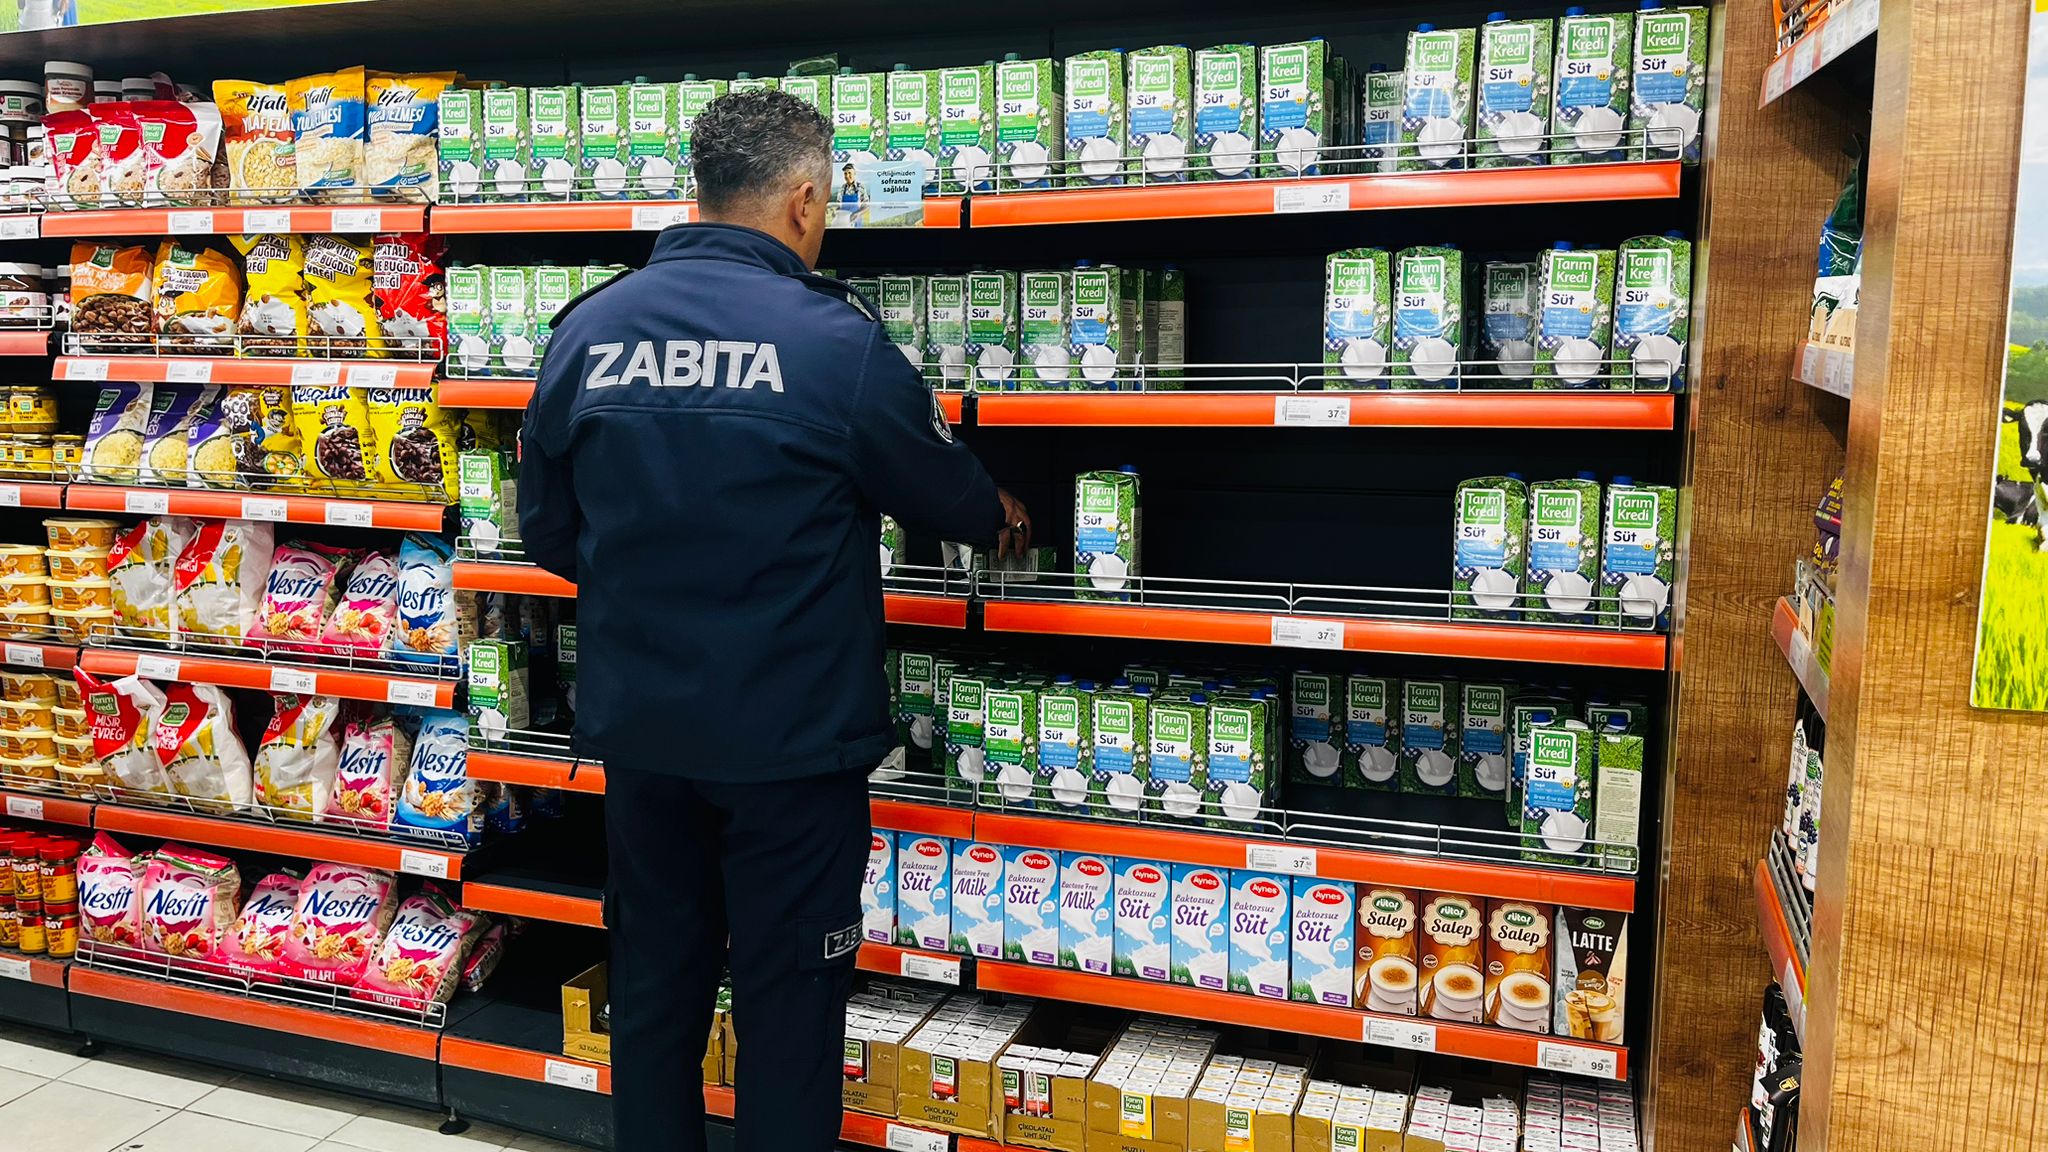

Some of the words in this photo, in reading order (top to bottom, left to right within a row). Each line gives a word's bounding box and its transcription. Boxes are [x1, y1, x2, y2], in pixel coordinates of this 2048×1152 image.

[1571, 22, 1608, 38] Tarım
[1646, 21, 1683, 33] Tarım
[1492, 31, 1528, 46] Tarım
[1571, 36, 1604, 50] Kredi
[1647, 33, 1680, 46] Kredi
[1494, 44, 1525, 57] Kredi
[1270, 53, 1302, 65] Tarım
[1642, 59, 1667, 70] Süt
[1272, 66, 1300, 77] Kredi
[1489, 68, 1512, 80] Süt
[1567, 63, 1591, 75] Süt
[1004, 69, 1032, 81] Tarım
[1006, 81, 1031, 92] Kredi
[635, 90, 661, 101] Tarım
[1270, 88, 1290, 100] Süt
[443, 99, 466, 108] Tarım
[637, 101, 659, 112] Kredi
[1004, 103, 1021, 113] Süt
[445, 108, 465, 118] Kredi
[635, 121, 651, 130] Süt
[443, 127, 458, 136] Süt
[1322, 194, 1333, 203] 37
[320, 254, 355, 275] BUĞDAY
[1405, 262, 1439, 275] Tarım
[1555, 258, 1591, 271] Tarım
[1078, 276, 1105, 286] Tarım
[1406, 273, 1437, 285] Kredi
[1556, 269, 1588, 283] Kredi
[973, 279, 1000, 289] Tarım
[1028, 279, 1057, 289] Tarım
[974, 289, 998, 300] Kredi
[1030, 289, 1055, 300] Kredi
[1079, 287, 1103, 297] Kredi
[1403, 296, 1425, 306] Süt
[1551, 294, 1574, 305] Süt
[971, 307, 989, 318] Süt
[1028, 308, 1046, 318] Süt
[1076, 306, 1093, 317] Süt
[586, 340, 784, 393] ZABITA
[1328, 410, 1338, 418] 37
[1085, 484, 1114, 496] Tarım
[1086, 496, 1111, 506] Kredi
[1466, 493, 1500, 505] Tarım
[1541, 495, 1575, 506] Tarım
[1616, 496, 1652, 508] Tarım
[1468, 505, 1497, 517] Kredi
[1542, 506, 1572, 518] Kredi
[1618, 509, 1648, 520] Kredi
[1083, 515, 1102, 525] Süt
[1464, 526, 1486, 537] Süt
[1538, 528, 1560, 539] Süt
[1613, 531, 1636, 542] Süt
[268, 570, 323, 598] Nesfit
[1318, 632, 1329, 640] 37
[954, 683, 980, 693] Tarım
[955, 693, 978, 703] Kredi
[991, 698, 1017, 708] Tarım
[1046, 700, 1074, 710] Tarım
[952, 711, 969, 720] Süt
[992, 708, 1015, 719] Kredi
[1048, 710, 1072, 721] Kredi
[1216, 712, 1246, 724] Tarım
[95, 715, 120, 727] MISIR
[989, 727, 1007, 736] Süt
[1218, 722, 1244, 734] Kredi
[1045, 730, 1063, 740] Süt
[1537, 735, 1570, 748] Tarım
[1215, 743, 1234, 753] Süt
[1539, 747, 1568, 759] Kredi
[1534, 768, 1556, 779] Süt
[919, 844, 941, 853] Aynes
[972, 850, 994, 859] Aynes
[1025, 856, 1048, 865] Aynes
[1293, 860, 1304, 868] 37
[902, 862, 937, 871] Laktozsuz
[1079, 863, 1102, 872] Aynes
[954, 869, 977, 877] Lactose
[1008, 874, 1045, 883] Laktozsuz
[1134, 869, 1159, 880] Aynes
[902, 872, 931, 891] Süt
[1062, 881, 1083, 890] Lactose
[1193, 875, 1217, 886] Aynes
[954, 878, 987, 896] Milk
[1252, 884, 1277, 894] Aynes
[79, 881, 133, 910] Nesfit
[1008, 884, 1039, 904] Süt
[1118, 888, 1156, 898] Laktozsuz
[1315, 891, 1341, 901] Aynes
[147, 889, 209, 916] Nesfit
[303, 889, 378, 918] Nesfit
[1062, 891, 1096, 910] Milk
[1175, 894, 1215, 904] Laktozsuz
[1118, 898, 1150, 918] Süt
[1234, 902, 1275, 913] Laktozsuz
[1175, 905, 1209, 926] Süt
[1296, 910, 1339, 920] Laktozsuz
[1234, 913, 1269, 935] Süt
[1368, 912, 1407, 930] Salep
[1297, 921, 1332, 942] Süt
[1432, 919, 1472, 938] Salep
[834, 928, 859, 951] ZAB
[1498, 925, 1539, 945] Salep
[1573, 931, 1613, 951] LATTE
[943, 971, 952, 979] 54
[1472, 1015, 1480, 1023] 1L
[1411, 1035, 1423, 1044] 95
[1591, 1062, 1604, 1071] 99
[1018, 1123, 1055, 1133] ÇİKOLATALI
